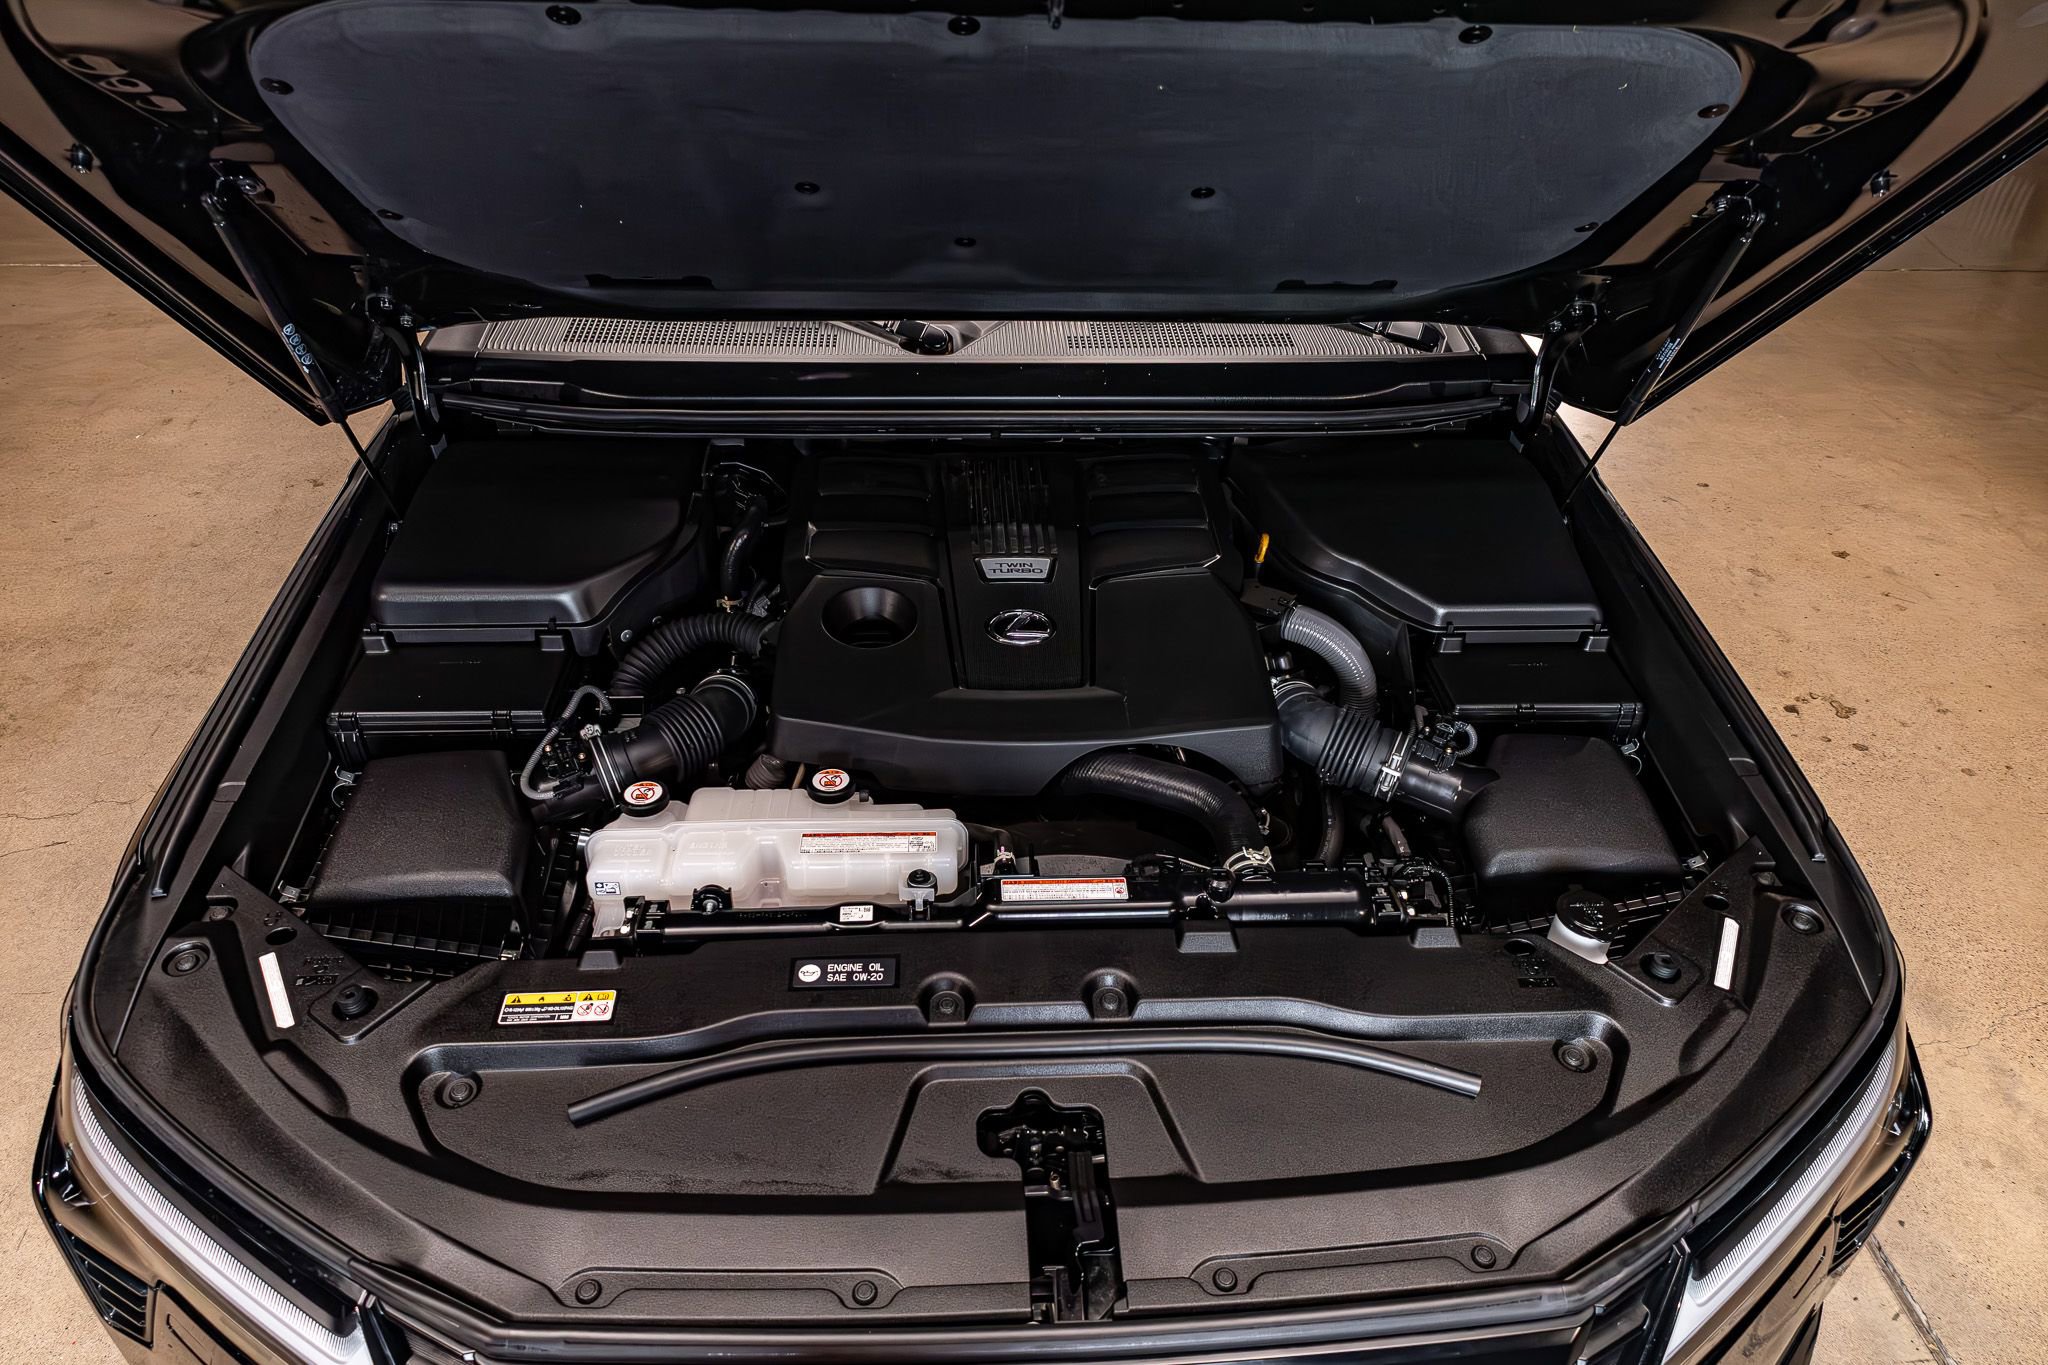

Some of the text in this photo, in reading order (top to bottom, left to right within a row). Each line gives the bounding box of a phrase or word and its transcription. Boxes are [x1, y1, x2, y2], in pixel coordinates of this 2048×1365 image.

[827, 962, 884, 972] ENGINE OIL
[826, 972, 884, 982] SAE 0W-20
